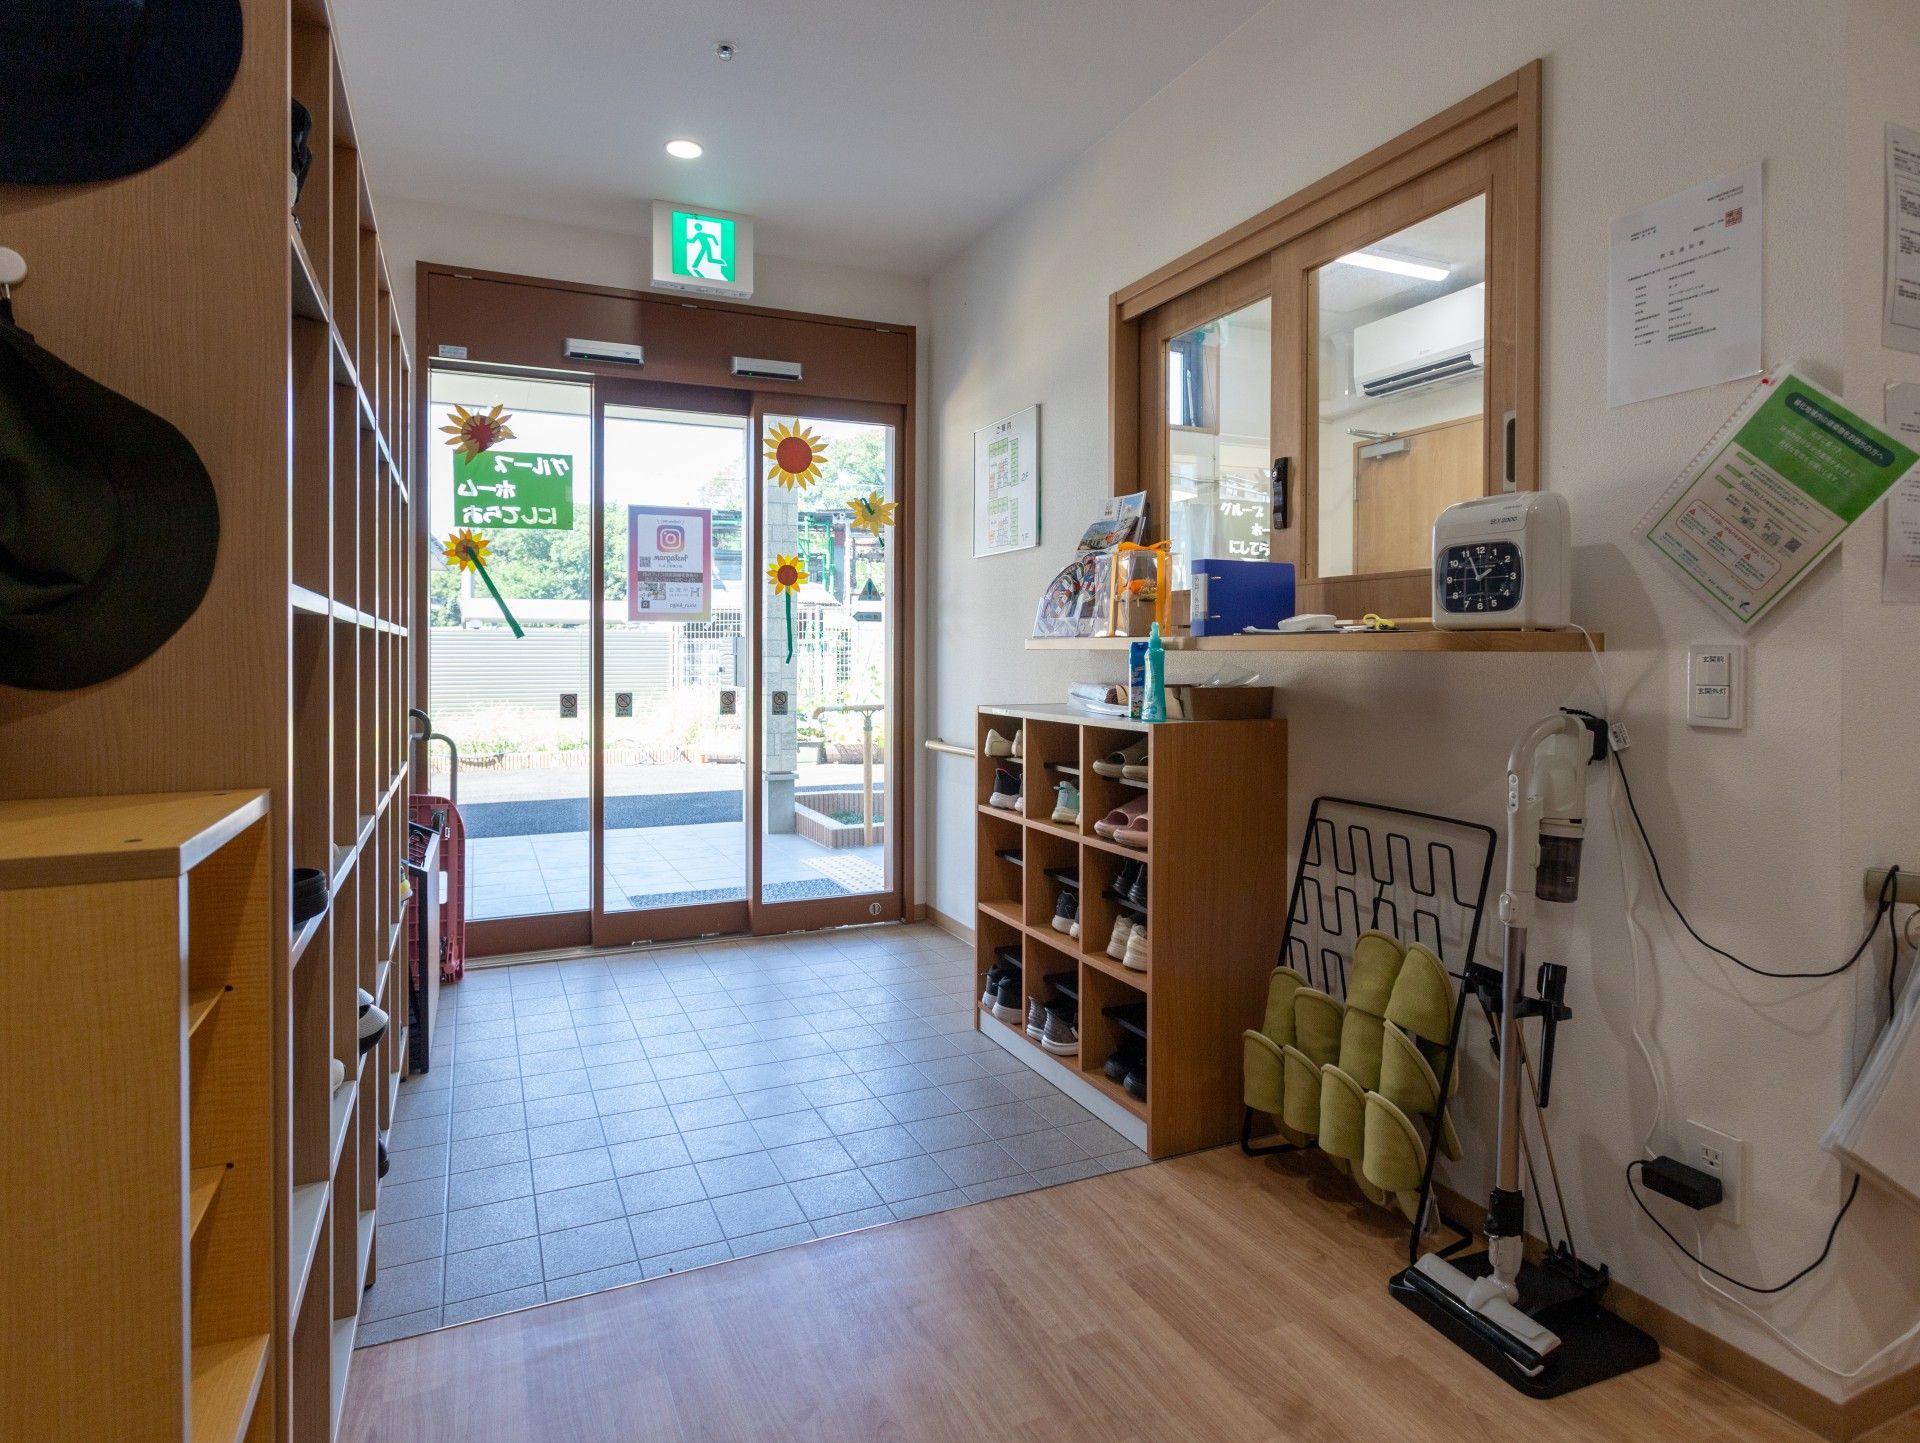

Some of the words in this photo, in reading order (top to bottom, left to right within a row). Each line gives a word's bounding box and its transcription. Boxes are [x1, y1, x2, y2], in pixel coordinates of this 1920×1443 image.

[1251, 522, 1270, 536] ホー
[1229, 540, 1270, 557] にしてら
[1476, 546, 1485, 554] 12
[1462, 550, 1470, 558] 11
[1504, 555, 1511, 563] 2
[1449, 560, 1459, 568] 10
[1510, 572, 1517, 580] 3
